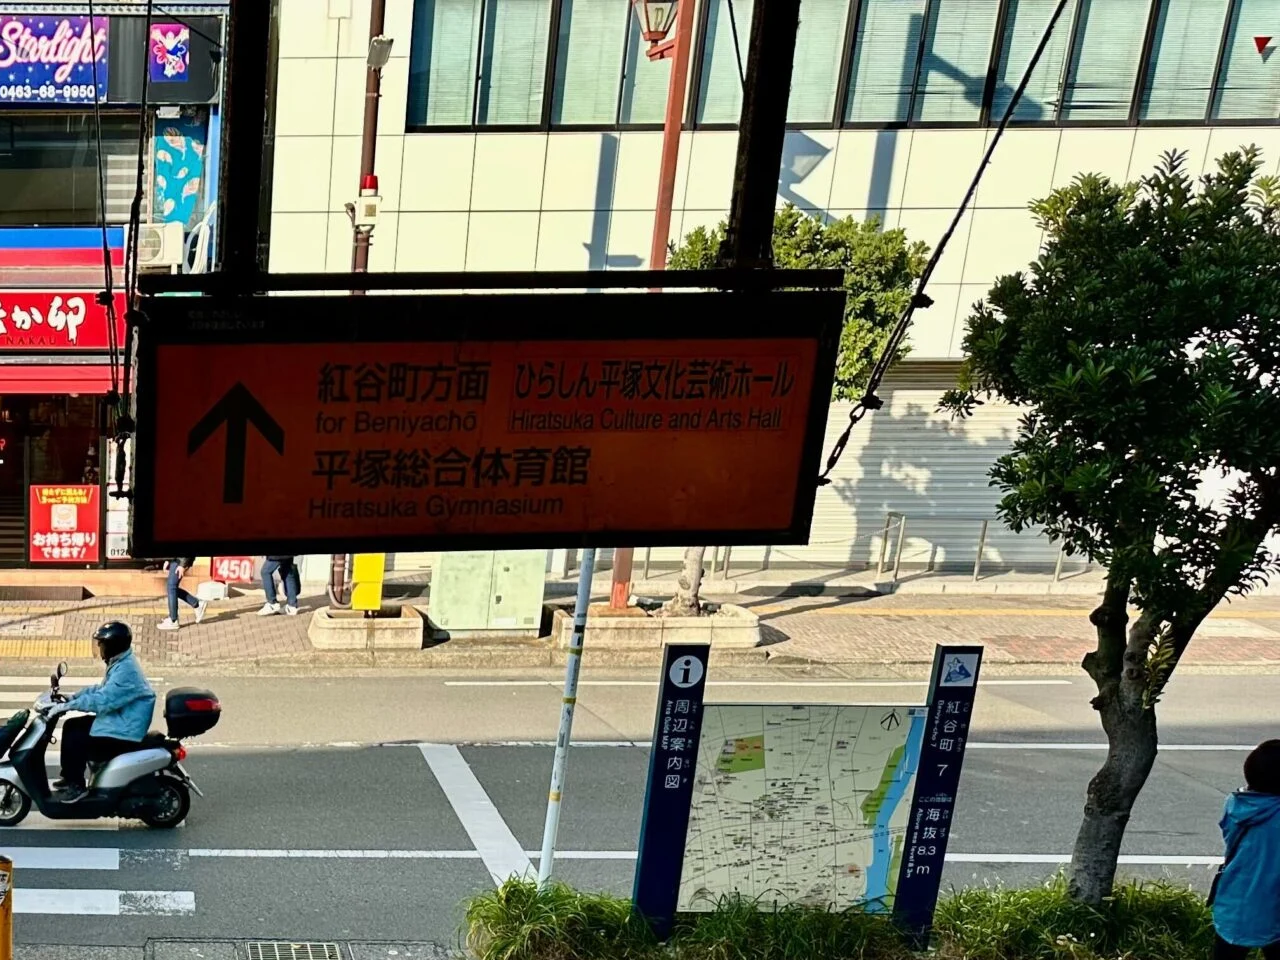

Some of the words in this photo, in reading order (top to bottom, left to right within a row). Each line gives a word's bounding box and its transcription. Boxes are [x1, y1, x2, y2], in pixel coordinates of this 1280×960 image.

[0, 85, 95, 99] 0463-68-9950
[6, 335, 56, 345] NAKAU
[318, 361, 490, 404] 紅谷町方面
[515, 359, 794, 402] ひらしん平塚文化芸術ホール
[316, 412, 350, 434] for
[354, 409, 478, 438] Beniyachō
[511, 409, 595, 431] Hiratsuka
[600, 408, 663, 431] Culture
[669, 407, 701, 429] and
[706, 407, 743, 429] Arts
[748, 406, 782, 428] Hall
[310, 446, 591, 490] 平塚総合体育館
[309, 496, 418, 520] Hiratsuka
[425, 495, 565, 521] Gymnasium
[32, 532, 96, 547] お持ち帰り
[939, 700, 961, 752] 紅谷町
[661, 738, 669, 750] MAP
[664, 699, 690, 789] 周辺案内図
[922, 808, 941, 839] 海抜
